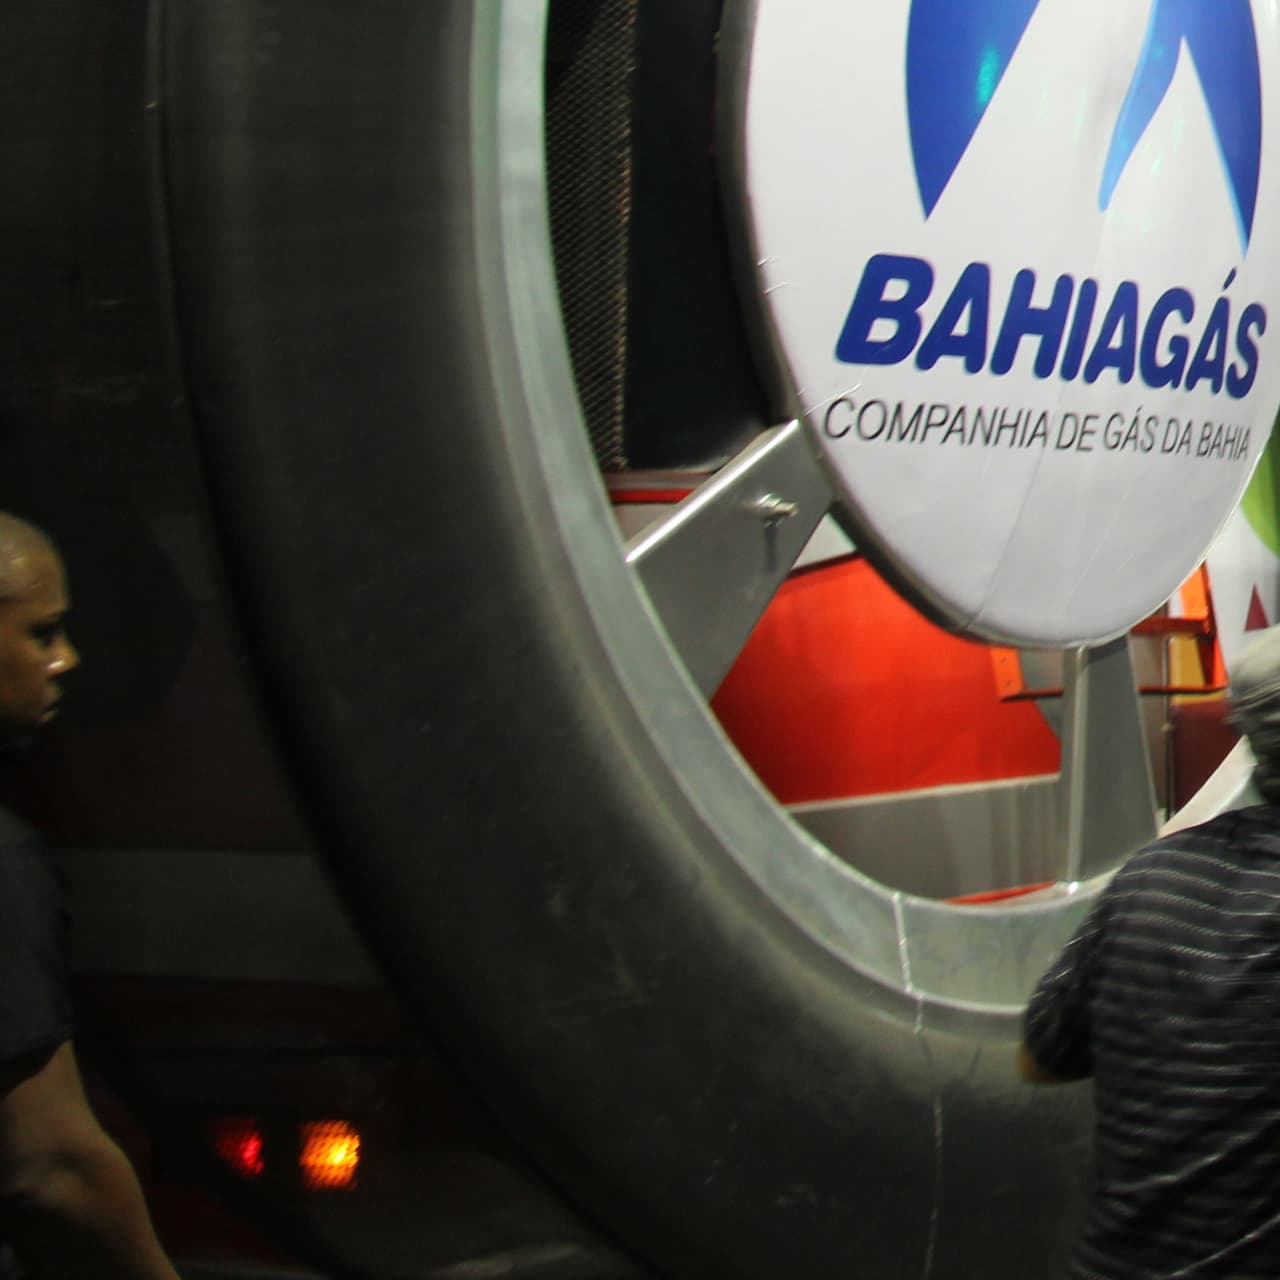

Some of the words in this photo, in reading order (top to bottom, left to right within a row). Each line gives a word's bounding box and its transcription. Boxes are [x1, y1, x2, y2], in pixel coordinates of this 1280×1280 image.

[835, 253, 1267, 400] BAHIAGÁS
[823, 397, 1047, 450] COMPANHIA
[1054, 412, 1100, 452] DE
[1103, 405, 1156, 453] GÁS
[1161, 413, 1192, 456] DA
[1195, 421, 1250, 462] BAHIA
